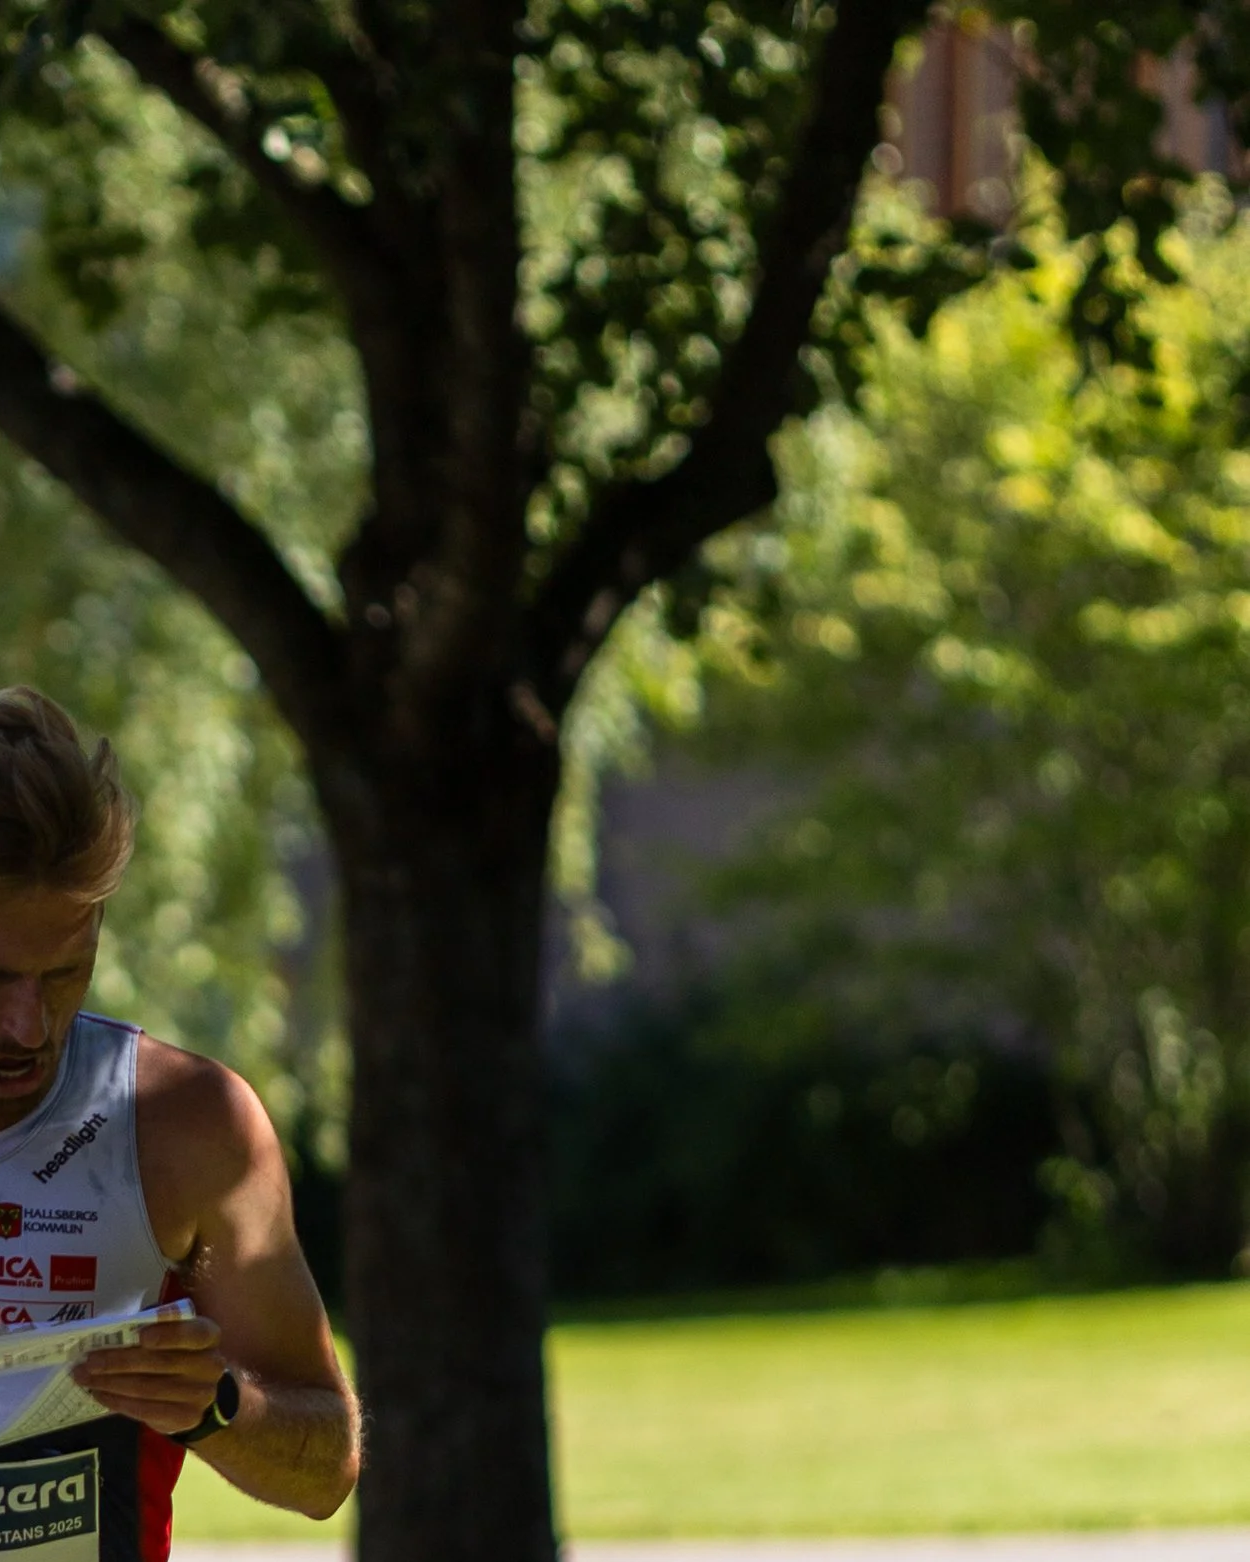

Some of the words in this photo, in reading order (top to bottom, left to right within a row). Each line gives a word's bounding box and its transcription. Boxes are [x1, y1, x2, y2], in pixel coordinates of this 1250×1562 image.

[32, 1112, 108, 1184] headlight
[23, 1208, 99, 1222] HALLSBERGS
[23, 1221, 83, 1234] KOMMUN
[18, 1279, 43, 1289] nära
[48, 1516, 82, 1537] 2025
